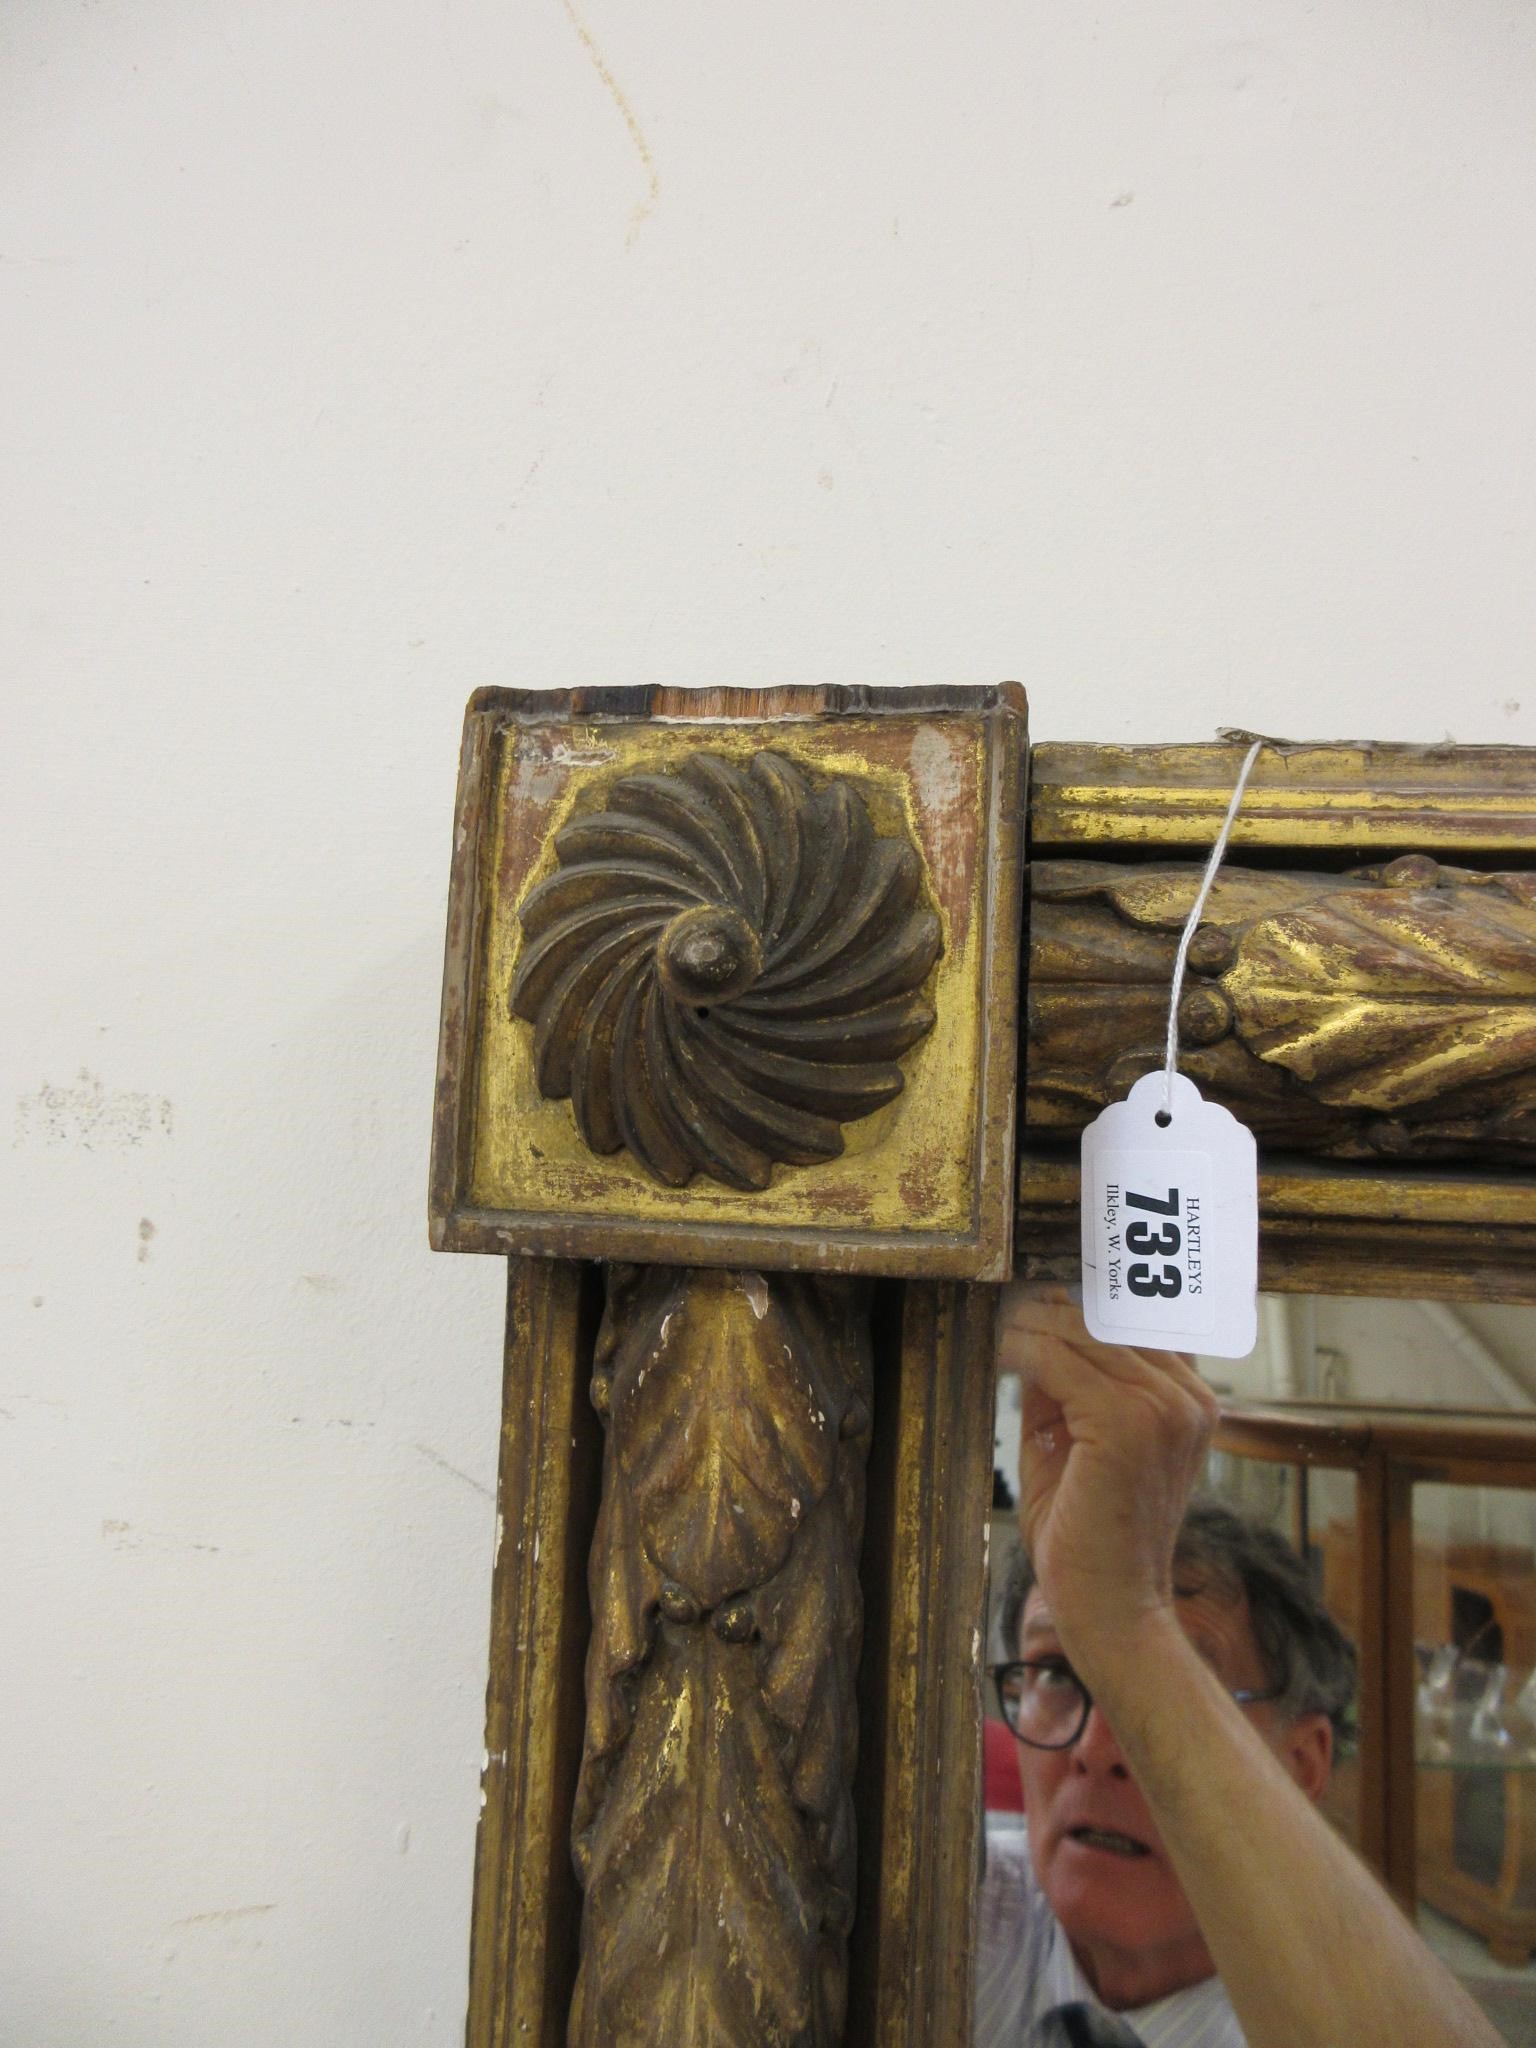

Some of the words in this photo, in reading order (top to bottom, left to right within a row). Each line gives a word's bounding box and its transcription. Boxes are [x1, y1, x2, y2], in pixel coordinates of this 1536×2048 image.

[1108, 1234, 1121, 1254] W.
[1125, 1188, 1182, 1299] 733
[1186, 1198, 1202, 1294] HARTLEYS
[1108, 1259, 1122, 1300] Yorks
